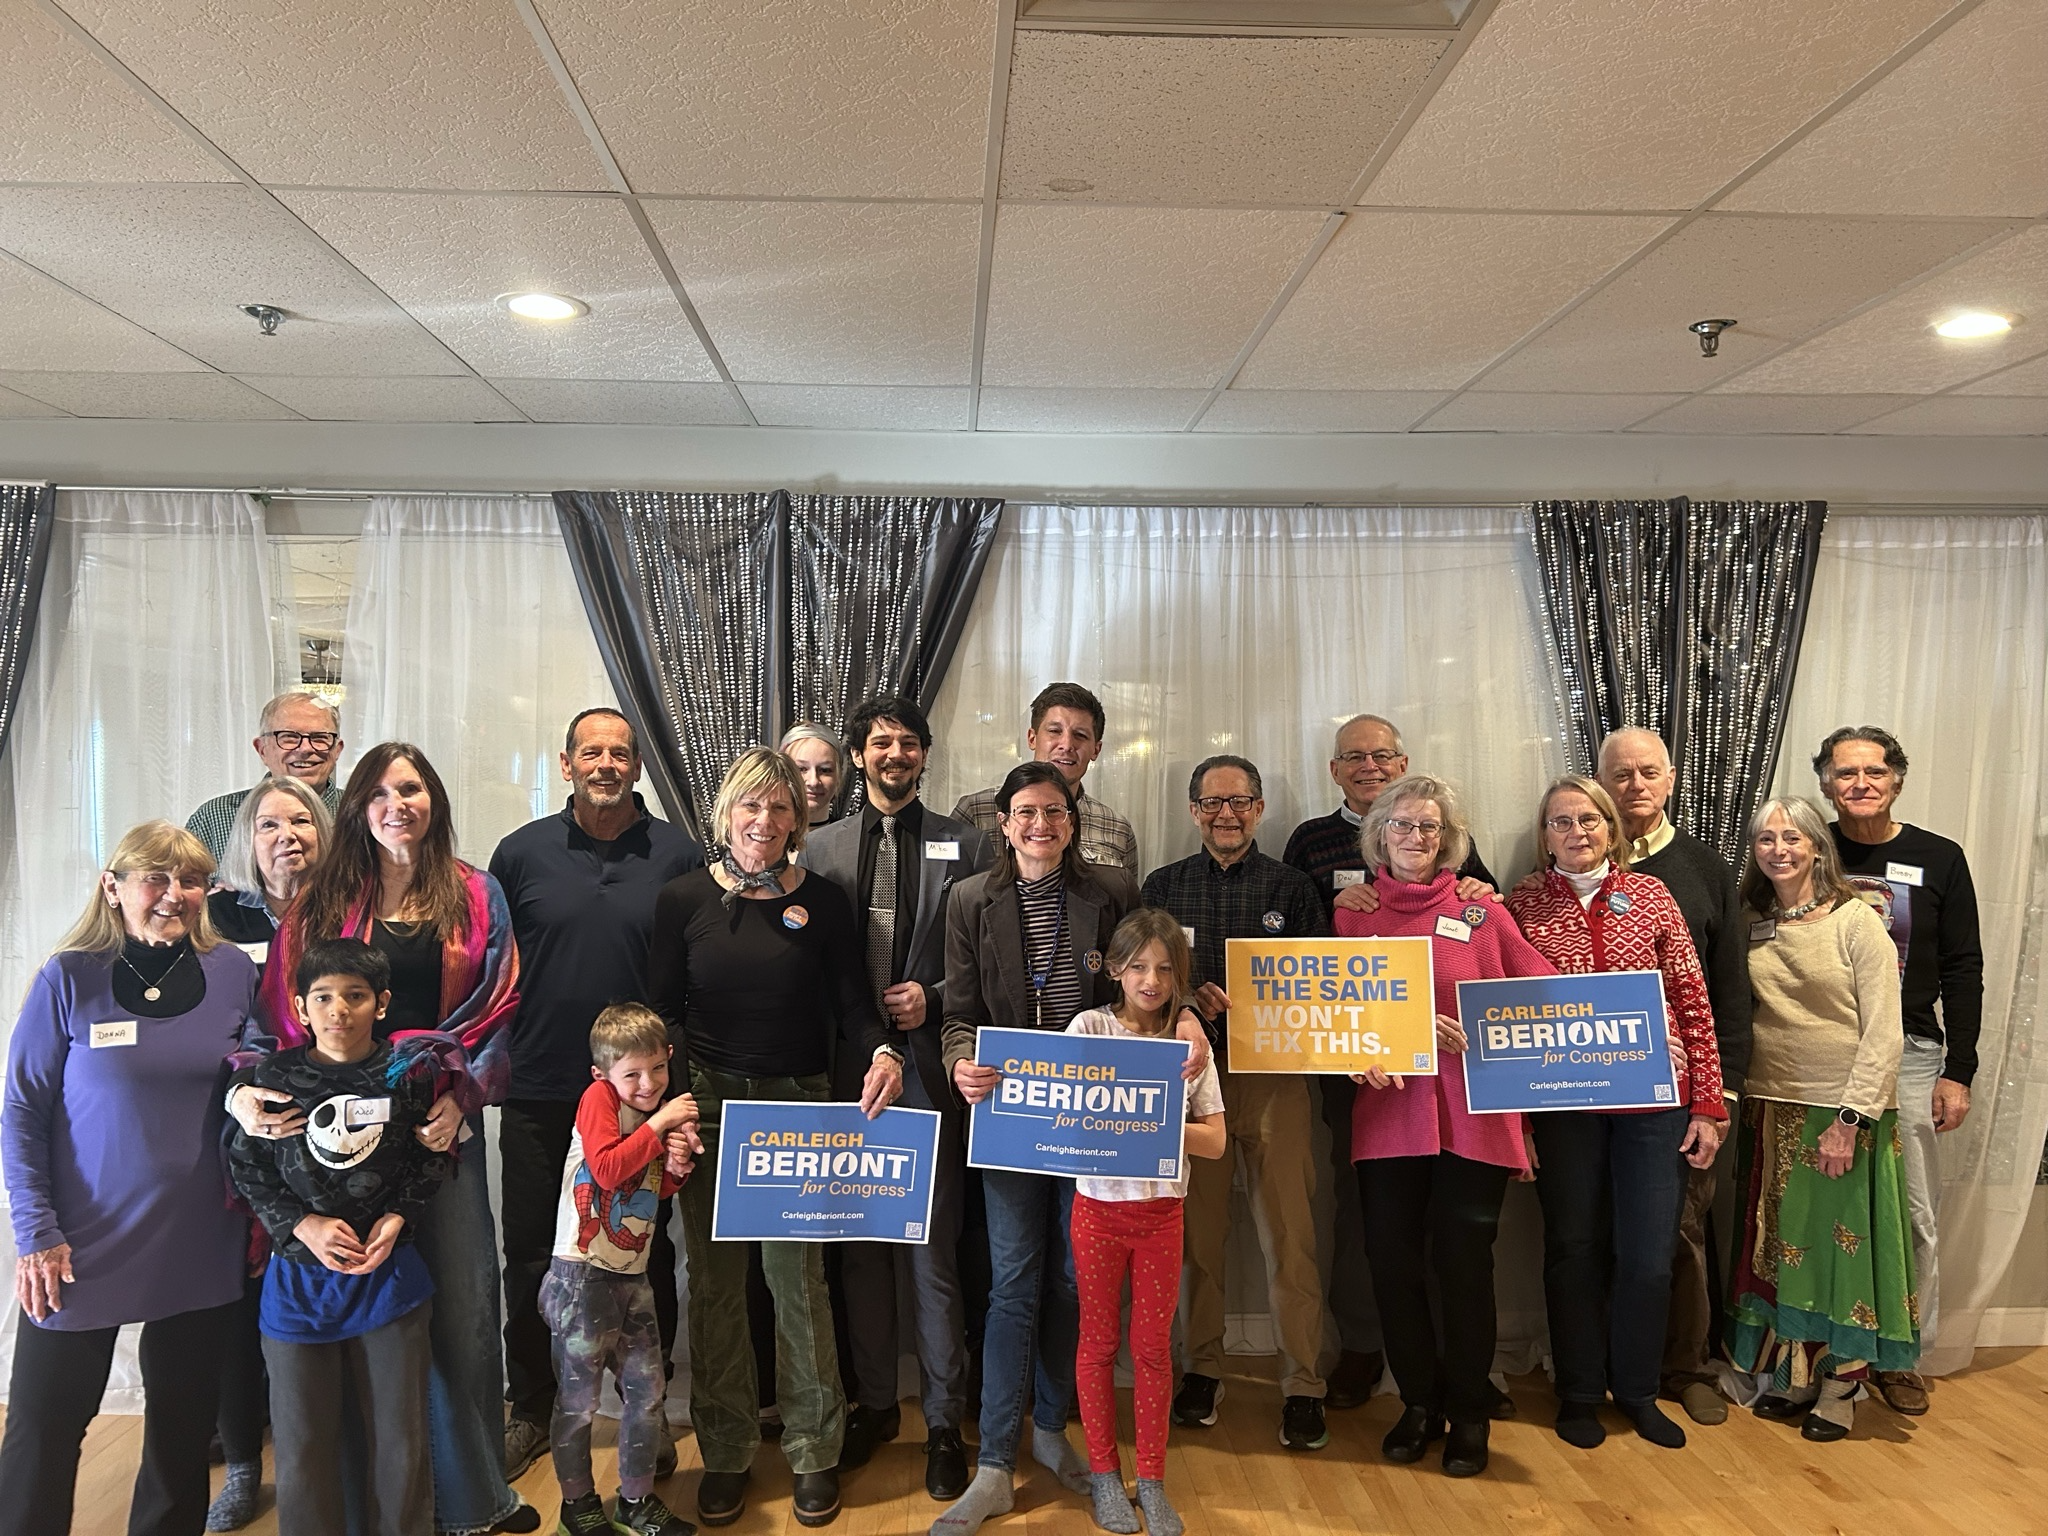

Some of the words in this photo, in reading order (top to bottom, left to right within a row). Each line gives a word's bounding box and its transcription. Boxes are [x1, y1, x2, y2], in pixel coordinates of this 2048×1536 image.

[1251, 955, 1339, 977] MORE
[1347, 955, 1388, 977] OF
[1252, 979, 1312, 1001] THE
[1319, 979, 1408, 1001] SAME
[1253, 1005, 1364, 1029] WON'T
[1485, 1002, 1594, 1021] CARLEIGH
[1254, 1031, 1303, 1053] FIX
[1308, 1031, 1391, 1055] THIS.
[1487, 1018, 1642, 1050] BERIONT
[1004, 1058, 1116, 1081] CARLEIGH
[1541, 1050, 1564, 1067] for
[1569, 1050, 1646, 1066] Congress
[1001, 1078, 1161, 1114] BERIONT
[1529, 1080, 1610, 1091] CarleighBeriont.com
[1052, 1112, 1079, 1130] for
[1082, 1116, 1159, 1135] Congress
[750, 1131, 864, 1148] CARLEIGH
[1035, 1143, 1118, 1157] CarleighBeriont.com
[747, 1150, 909, 1179] BERIONT
[798, 1180, 825, 1197] for
[829, 1181, 906, 1198] Congress
[782, 1211, 864, 1221] CarleighBeriont.com
